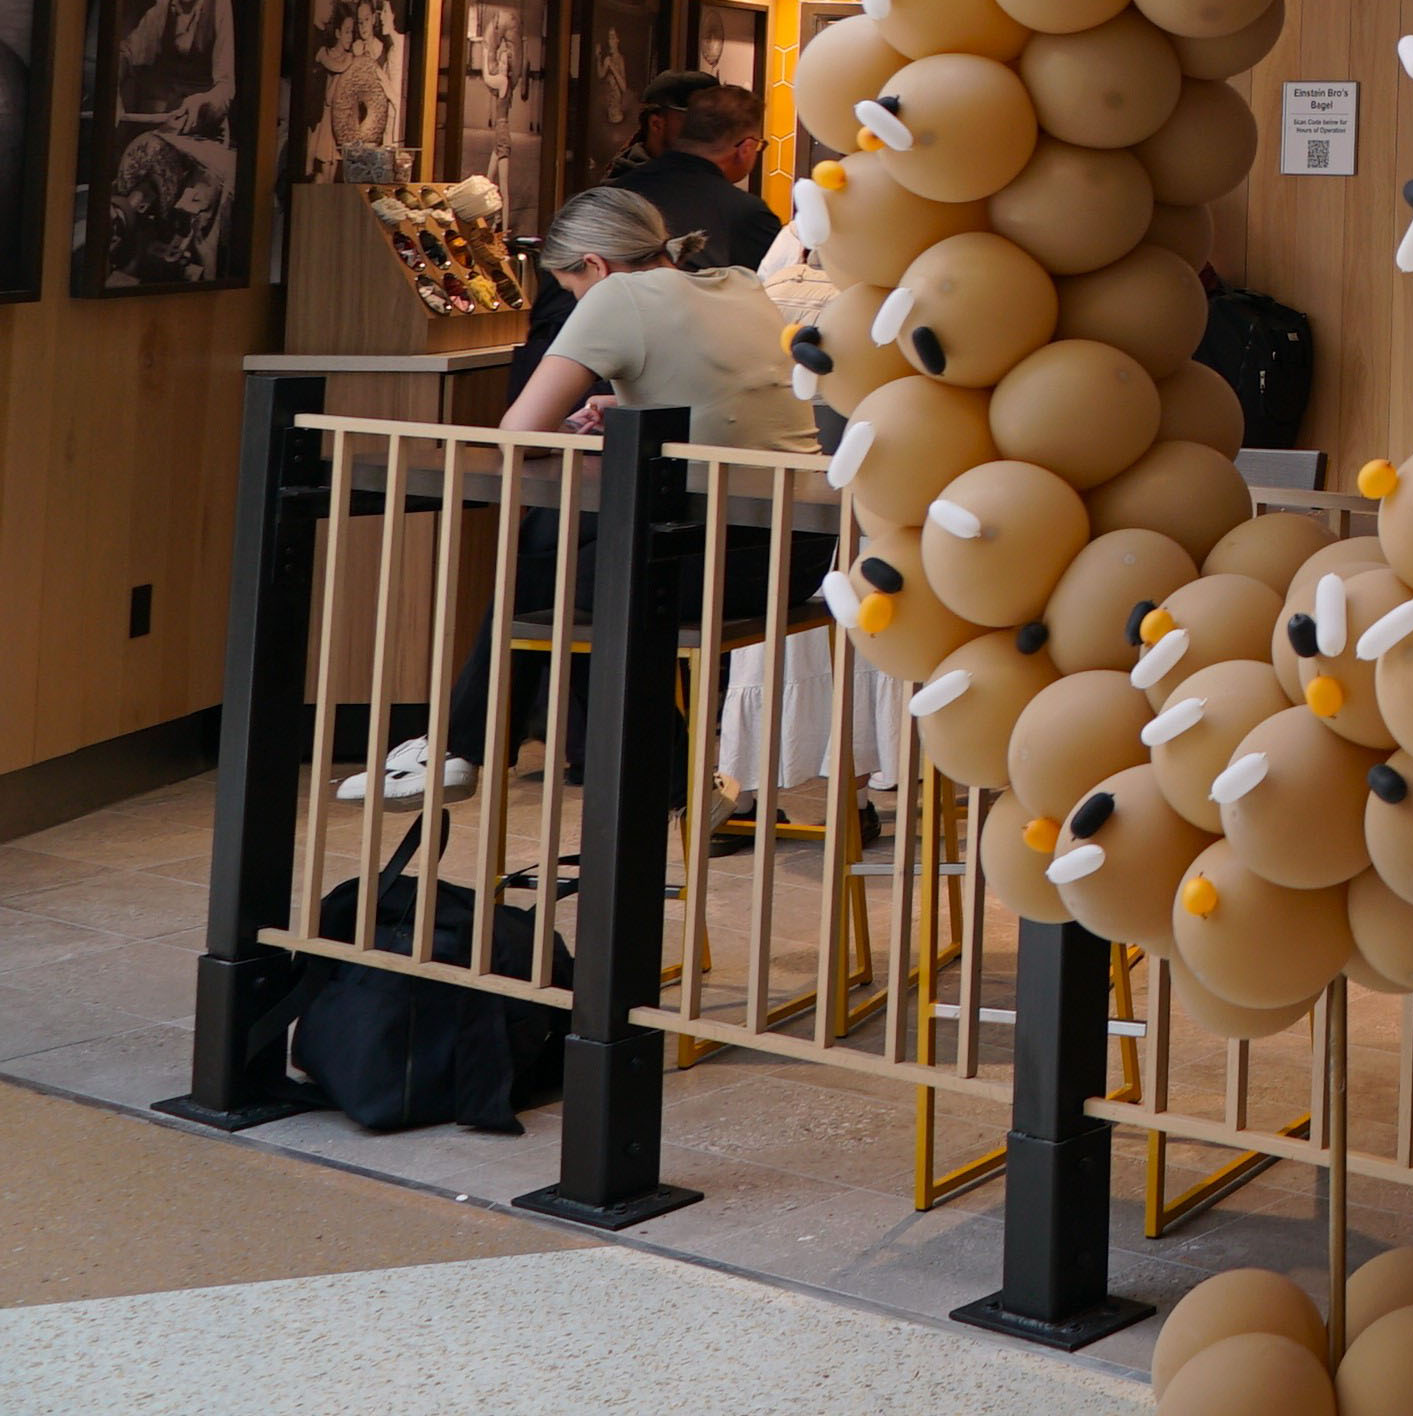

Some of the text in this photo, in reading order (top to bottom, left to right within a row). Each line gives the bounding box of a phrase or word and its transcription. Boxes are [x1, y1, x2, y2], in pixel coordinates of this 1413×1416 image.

[1294, 88, 1348, 98] Einstein Bro's
[1310, 100, 1333, 111] Bagel
